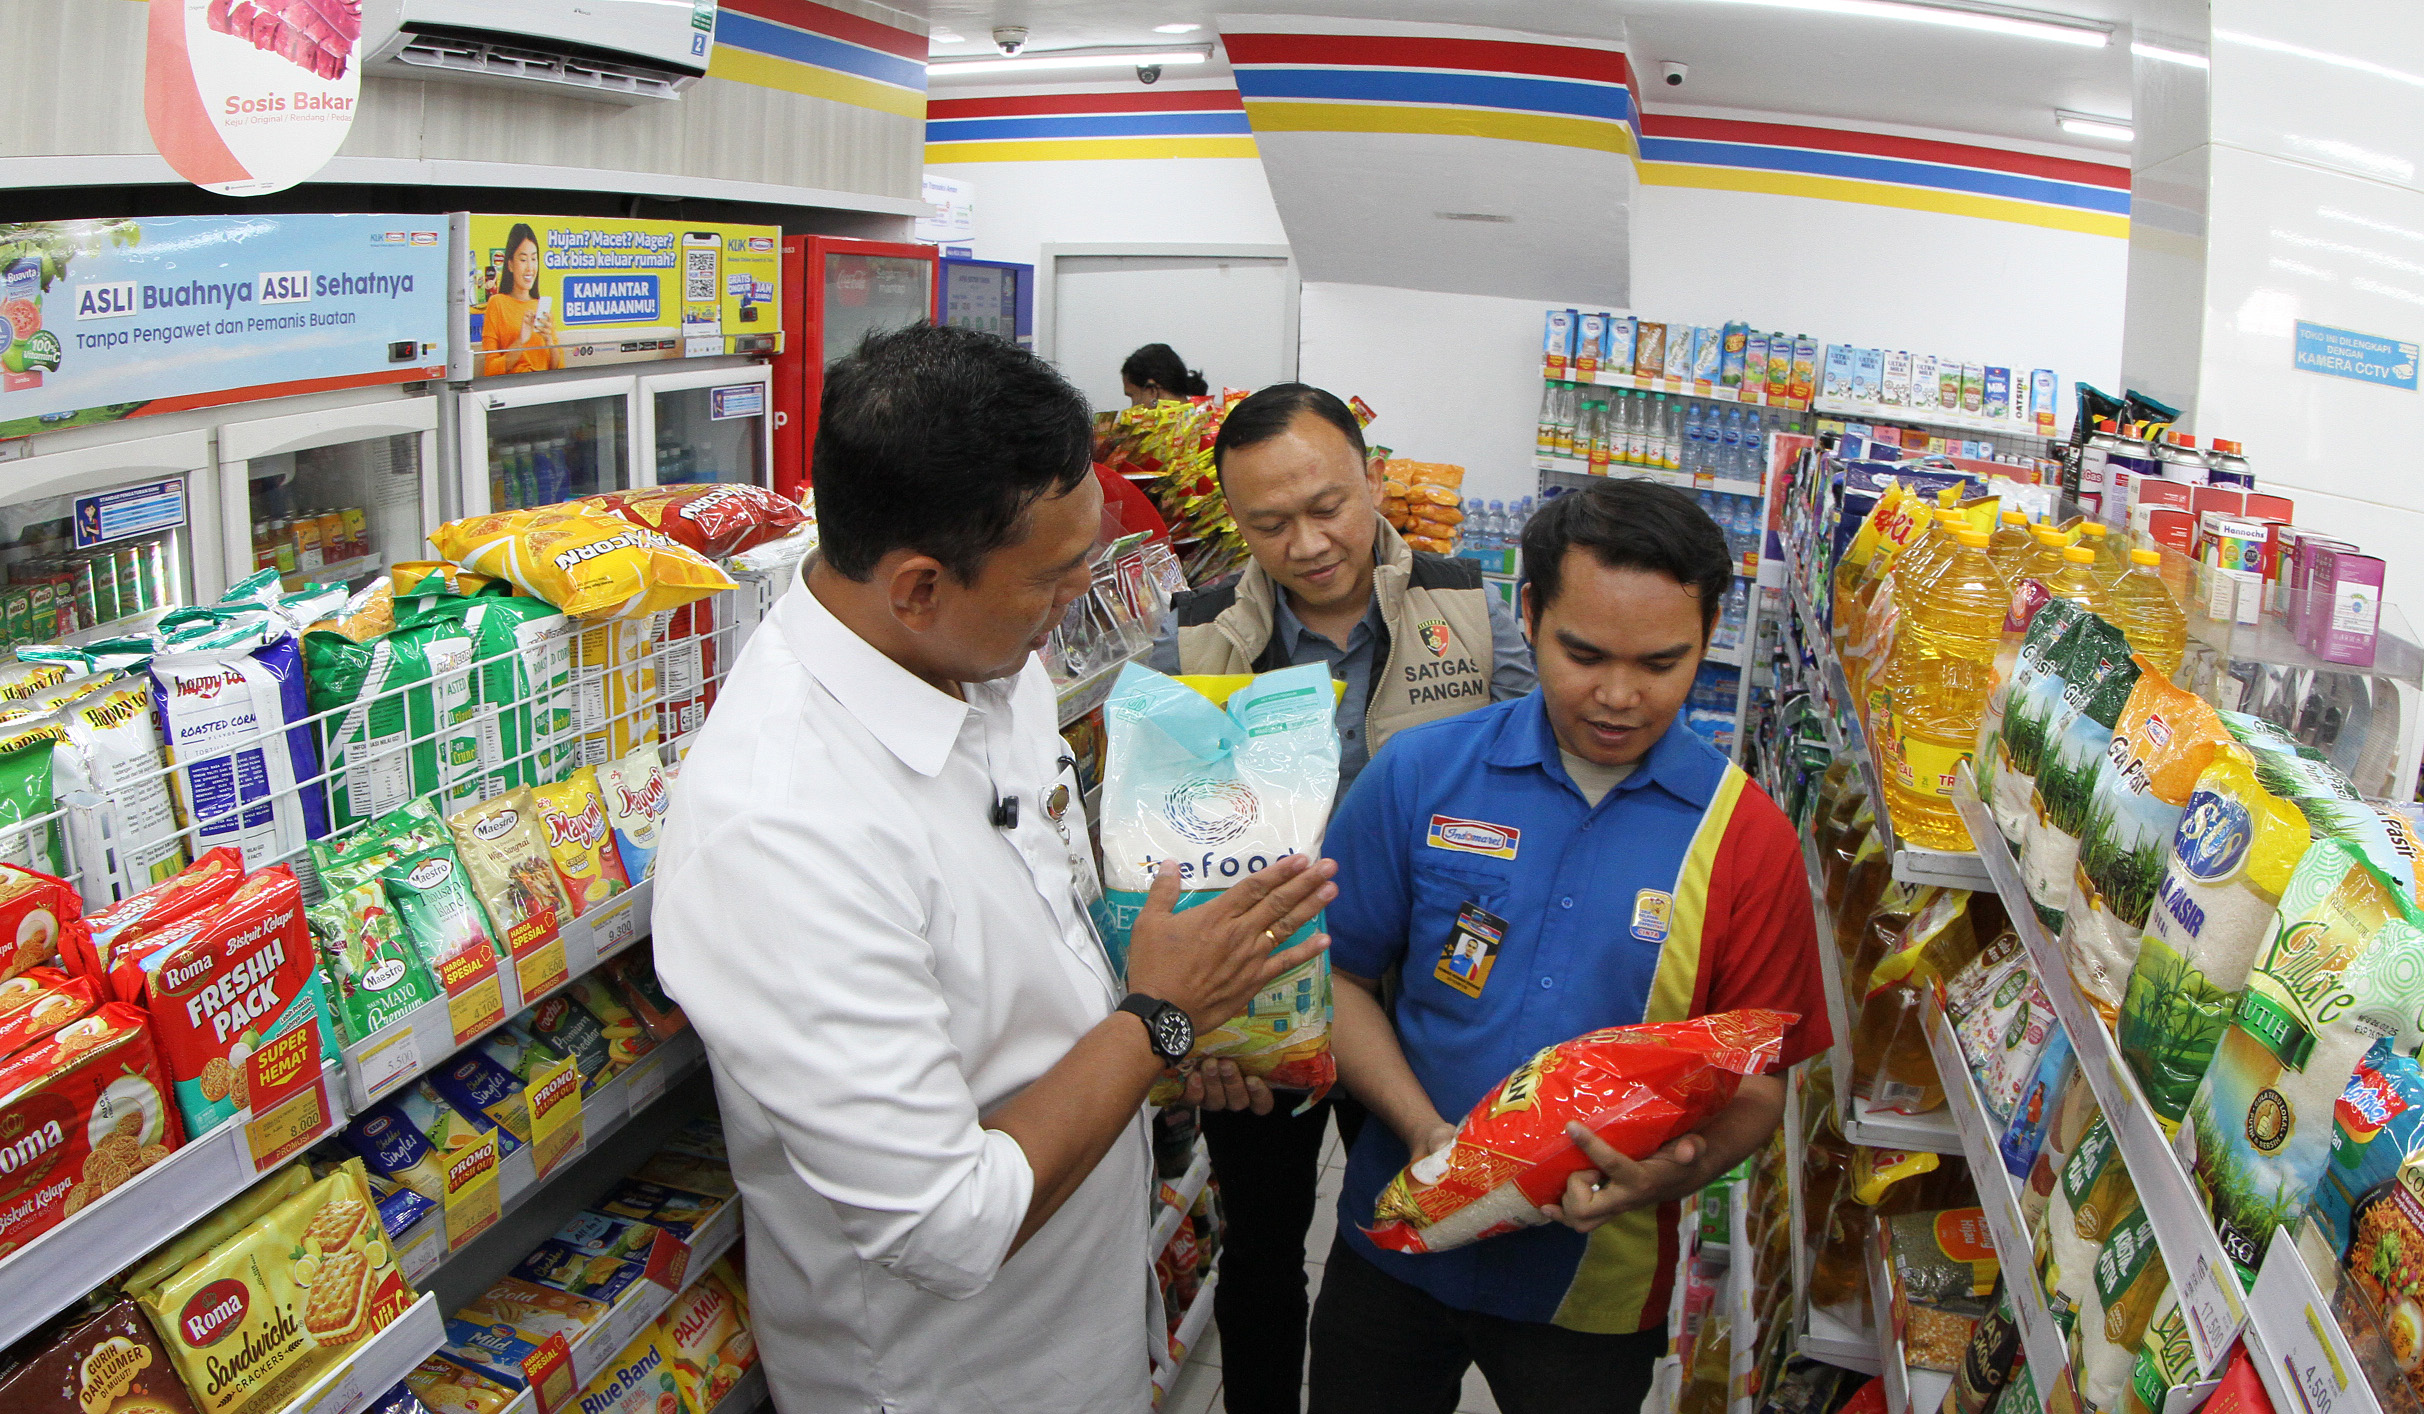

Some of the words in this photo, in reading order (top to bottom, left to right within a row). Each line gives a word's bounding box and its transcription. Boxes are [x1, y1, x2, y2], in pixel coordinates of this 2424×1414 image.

[694, 37, 703, 51] 2
[224, 92, 286, 115] Sosis
[293, 91, 353, 111] Bakar
[224, 118, 243, 127] Keju
[250, 114, 283, 125] Original
[290, 113, 325, 123] Rendang
[331, 113, 352, 122] Pedas
[547, 230, 591, 249] Hujan?
[592, 231, 633, 249] Macet?
[634, 233, 675, 251] Mager?
[543, 251, 568, 267] Gak
[570, 252, 595, 268] bisa
[596, 252, 632, 268] keluar
[634, 253, 677, 269] rumah?
[7, 269, 36, 283] Buavita
[79, 286, 134, 316] ASLI
[143, 279, 252, 311] Buahnya
[262, 274, 309, 302] ASLI
[315, 272, 415, 299] Sehatnya
[573, 282, 609, 299] KAMI
[610, 281, 650, 299] ANTAR
[566, 299, 656, 317] BELANJAANMU!
[76, 331, 129, 350] Tanpa
[133, 321, 211, 345] Pengawet
[215, 317, 244, 334] dan
[247, 313, 306, 333] Pemanis
[309, 310, 356, 328] Buatan
[2300, 329, 2324, 341] TOKO
[2326, 334, 2338, 344] INI
[2339, 336, 2392, 354] DILENGKAPI
[2297, 351, 2352, 372] KAMERA
[2355, 362, 2390, 378] CCTV
[2326, 345, 2364, 359] DENGAN
[2016, 376, 2025, 419] OATSIDE
[2223, 525, 2265, 539] Hannochs
[9, 602, 26, 614] MILO
[34, 592, 51, 602] MILO
[1404, 657, 1480, 683] SATGAS
[175, 675, 221, 699] happy
[1408, 678, 1484, 706] PANGAN
[86, 700, 133, 728] Happy
[180, 720, 229, 738] ROASTED
[230, 713, 257, 728] CORN
[477, 814, 515, 837] Maestro
[1444, 828, 1502, 847] Indomaret
[504, 838, 531, 856] Sangrai
[2381, 819, 2417, 862] Pasir
[410, 864, 449, 886] Maestro
[415, 877, 466, 907] Thousand
[433, 893, 466, 918] Island
[226, 927, 263, 957] Biskuit
[262, 908, 295, 936] Kelapa
[510, 922, 532, 939] HARGA
[512, 924, 547, 949] SPESIAL
[608, 920, 632, 942] 9.300
[1637, 929, 1660, 939] CINTA
[166, 955, 214, 991] Roma
[366, 963, 403, 988] Maestro
[443, 958, 467, 974] HARGA
[446, 961, 484, 985] SPESIAL
[186, 938, 287, 1030] FRESHH
[379, 982, 417, 1012] MAYO
[533, 976, 560, 997] PROMOSI
[212, 976, 284, 1045] PACK
[368, 997, 424, 1033] Premium
[473, 997, 499, 1019] 4.100
[466, 1016, 495, 1038] PROMOSI
[551, 1014, 591, 1050] Premium
[258, 1028, 308, 1069] SUPER
[567, 1027, 601, 1058] Cheddar
[259, 1045, 310, 1088] HEMAT
[387, 1049, 414, 1074] 5.500
[456, 1063, 478, 1079] KRAFT
[471, 1072, 506, 1105] Singles
[535, 1070, 575, 1106] PROMO
[535, 1092, 560, 1119] FLUSH
[560, 1081, 577, 1100] OUT
[290, 1112, 320, 1138] 8.000
[2254, 1092, 2268, 1107] GULA
[2278, 1103, 2290, 1132] LOKAL
[366, 1119, 390, 1136] KRAFT
[375, 1129, 401, 1150] Cheddar
[0, 1118, 66, 1180] oma
[276, 1133, 311, 1160] PROMOSI
[380, 1134, 418, 1167] Singles
[2258, 1136, 2282, 1151] BERSIH
[450, 1143, 493, 1180] PROMO
[449, 1165, 477, 1194] FLUSH
[476, 1157, 495, 1174] OUT
[34, 1175, 74, 1209] Kelapa
[1960, 1219, 1976, 1245] Hijau
[186, 1292, 244, 1342] Roma
[671, 1287, 725, 1349] PALMIA
[2203, 1300, 2226, 1349] 17.500
[205, 1303, 300, 1397] Sandwichi
[466, 1331, 514, 1351] Mild
[87, 1344, 120, 1378] GURIH
[235, 1351, 286, 1394] CRACKERS
[523, 1350, 545, 1369] HARGA
[527, 1348, 559, 1378] SPESIAL
[82, 1376, 105, 1408] DAN
[102, 1345, 144, 1387] LUMER
[579, 1376, 623, 1414] Blue
[615, 1343, 664, 1391] Band
[2303, 1365, 2332, 1414] 4.500
[98, 1384, 113, 1401] DI
